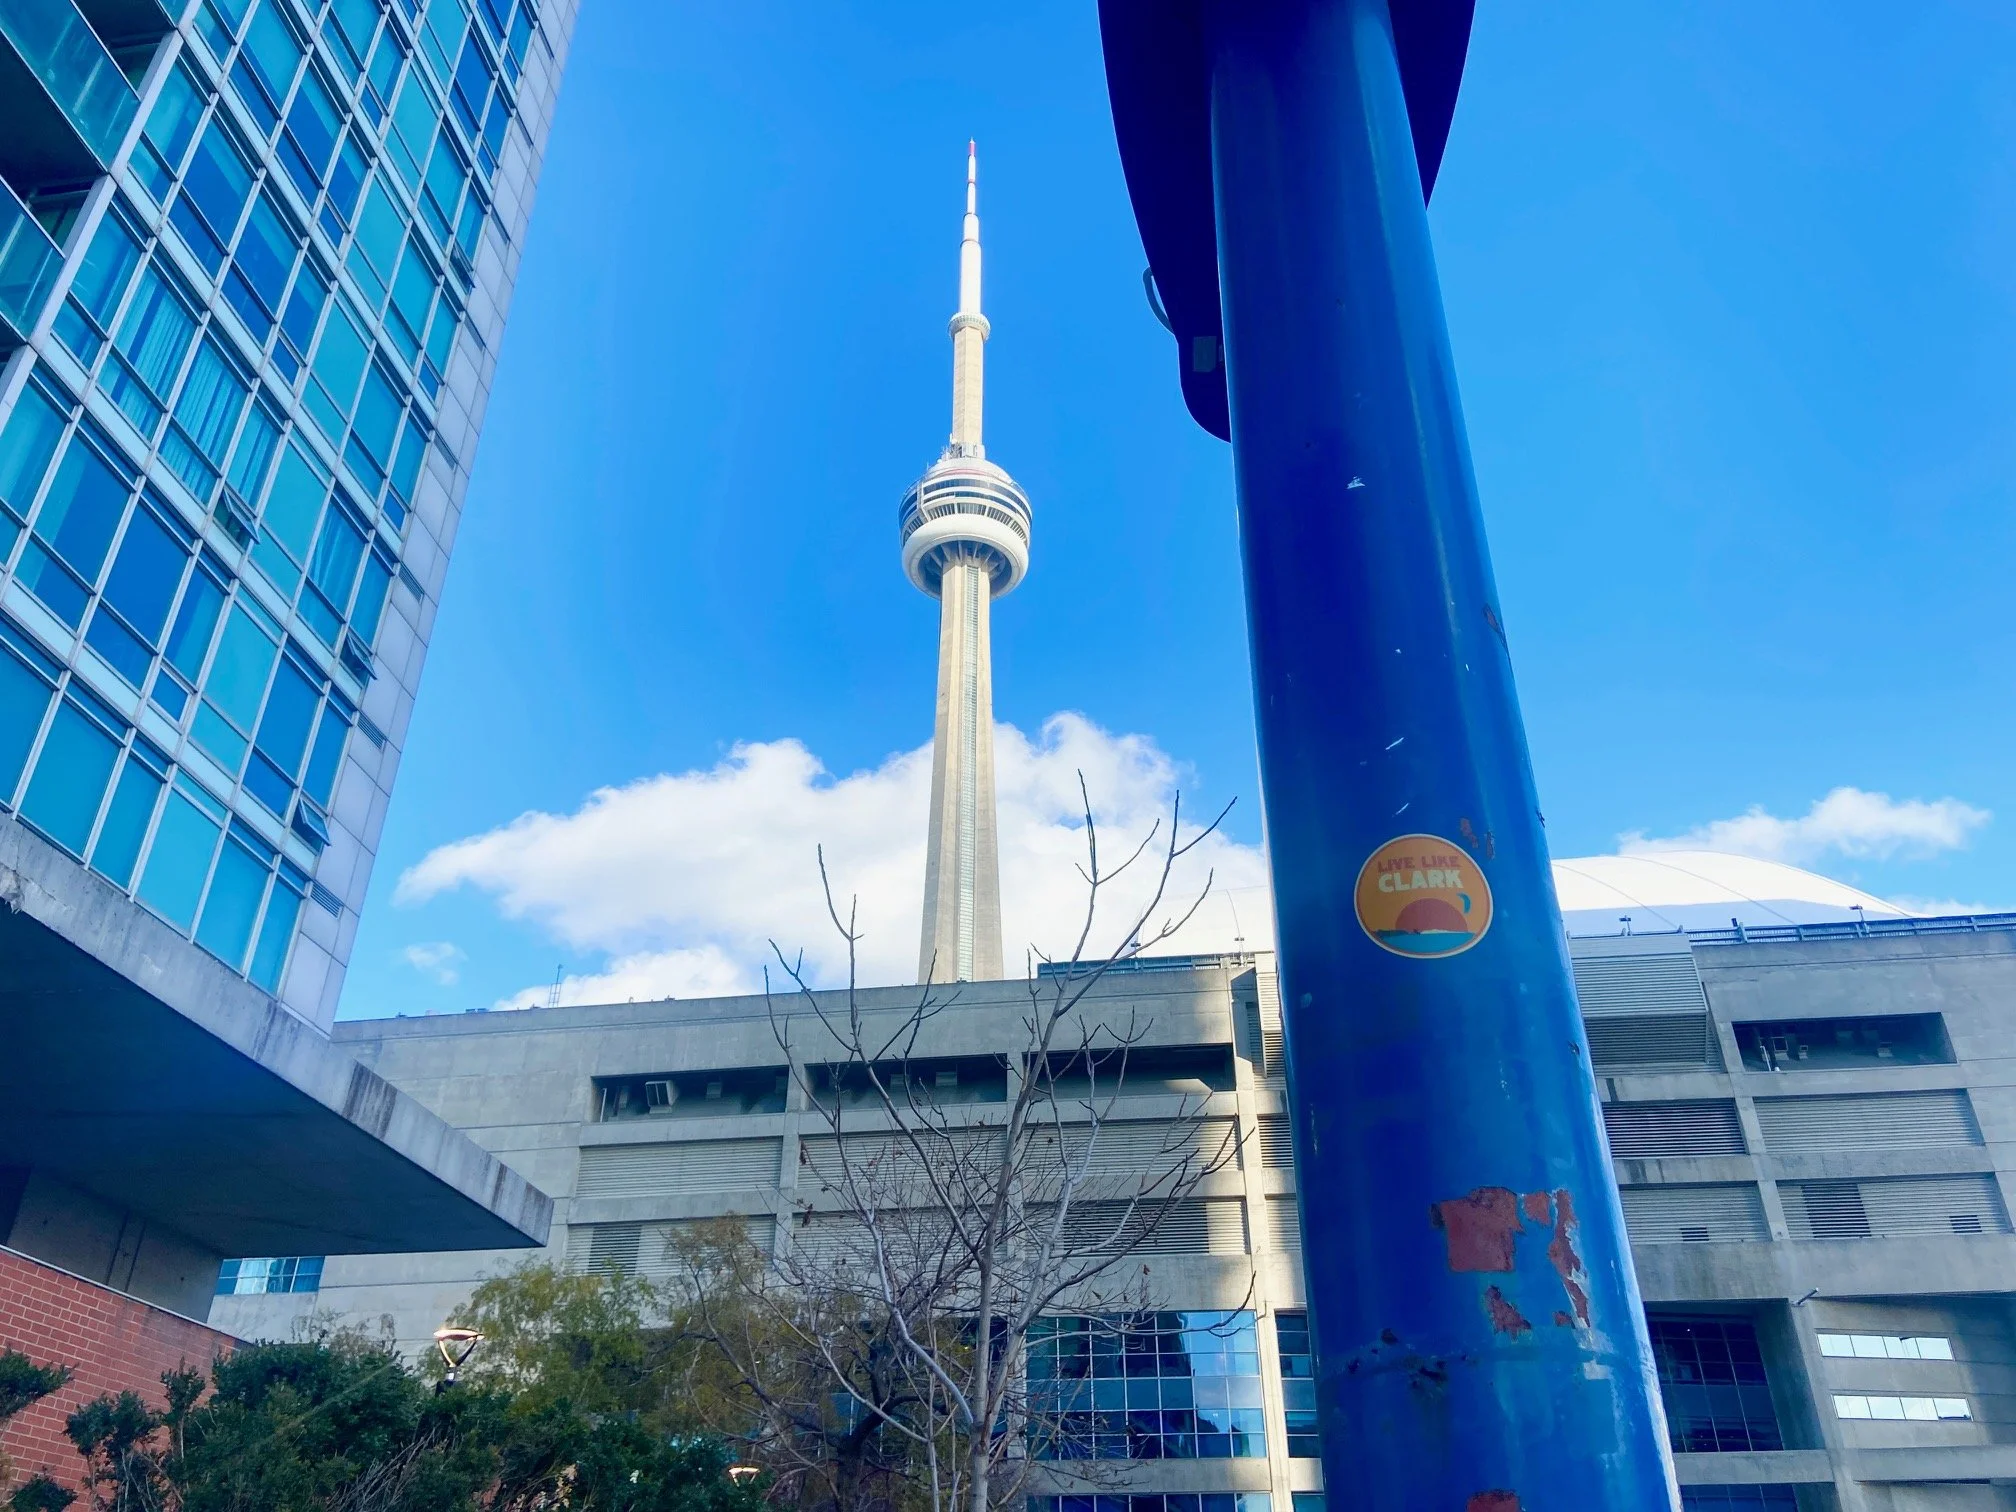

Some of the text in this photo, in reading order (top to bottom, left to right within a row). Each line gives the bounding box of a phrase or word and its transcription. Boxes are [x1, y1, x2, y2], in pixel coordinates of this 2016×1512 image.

[1378, 855, 1462, 873] LIVE LIKE
[1378, 869, 1464, 893] CLARK
